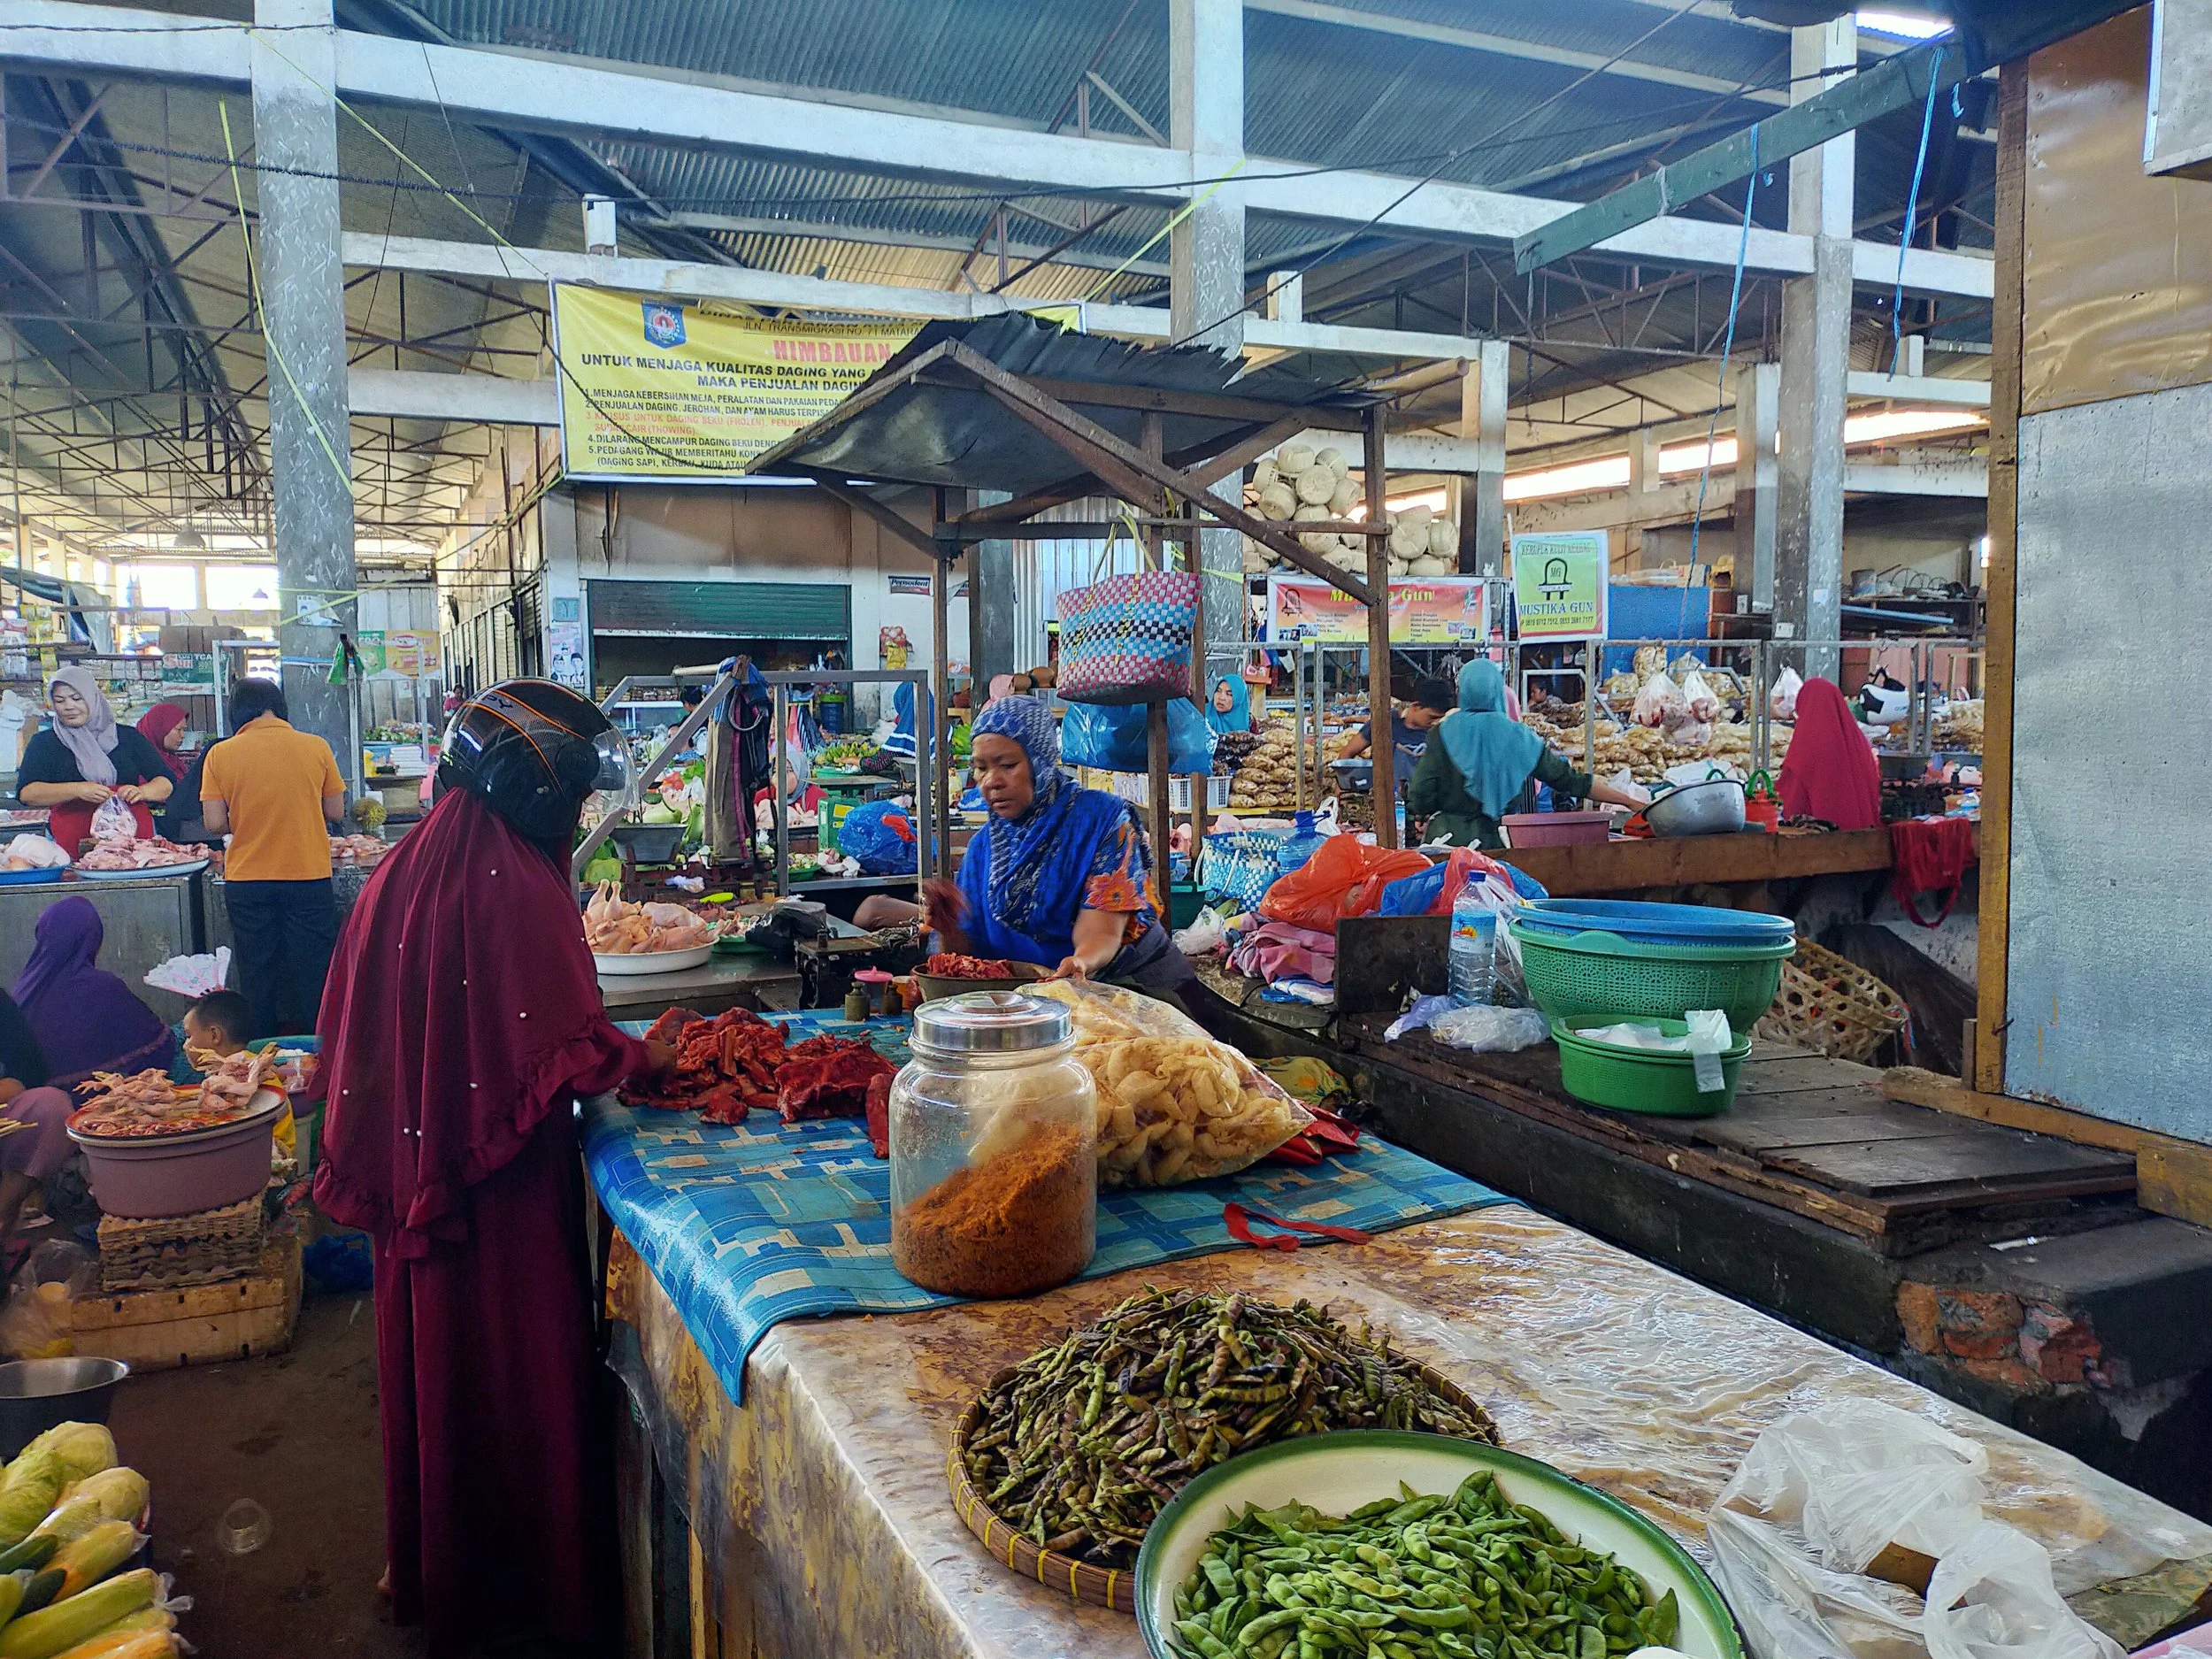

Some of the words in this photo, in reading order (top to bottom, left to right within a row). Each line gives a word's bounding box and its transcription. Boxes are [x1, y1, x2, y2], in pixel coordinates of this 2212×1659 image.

[881, 327, 919, 337] MATARA
[773, 340, 893, 362] HIMBAUAN
[582, 354, 632, 366] UNTUK
[637, 357, 702, 372] MENJAGA
[706, 361, 772, 375] KUALITAS
[777, 365, 826, 377] DAGING
[832, 368, 865, 378] YANG
[697, 375, 736, 388] MAKA
[741, 378, 818, 390] PENJUALAN
[824, 380, 864, 391] DAGIN
[636, 390, 689, 401] KEBERSIHAN
[718, 395, 764, 404] PERALATAN
[765, 396, 782, 405] DAN
[784, 396, 818, 406] PAKAIAN
[726, 406, 742, 415] DAN
[743, 406, 766, 416] AYAM
[768, 407, 795, 416] HARUS
[634, 413, 664, 422] UNTUK
[666, 415, 699, 424] DAGING
[641, 436, 697, 446] MENCAMPUR
[698, 438, 731, 447] DAGING
[676, 449, 736, 458] MEMBERITAHU
[1401, 588, 1433, 602] Gun
[1520, 603, 1565, 615] MUSTIKA
[1571, 602, 1593, 612] GUN
